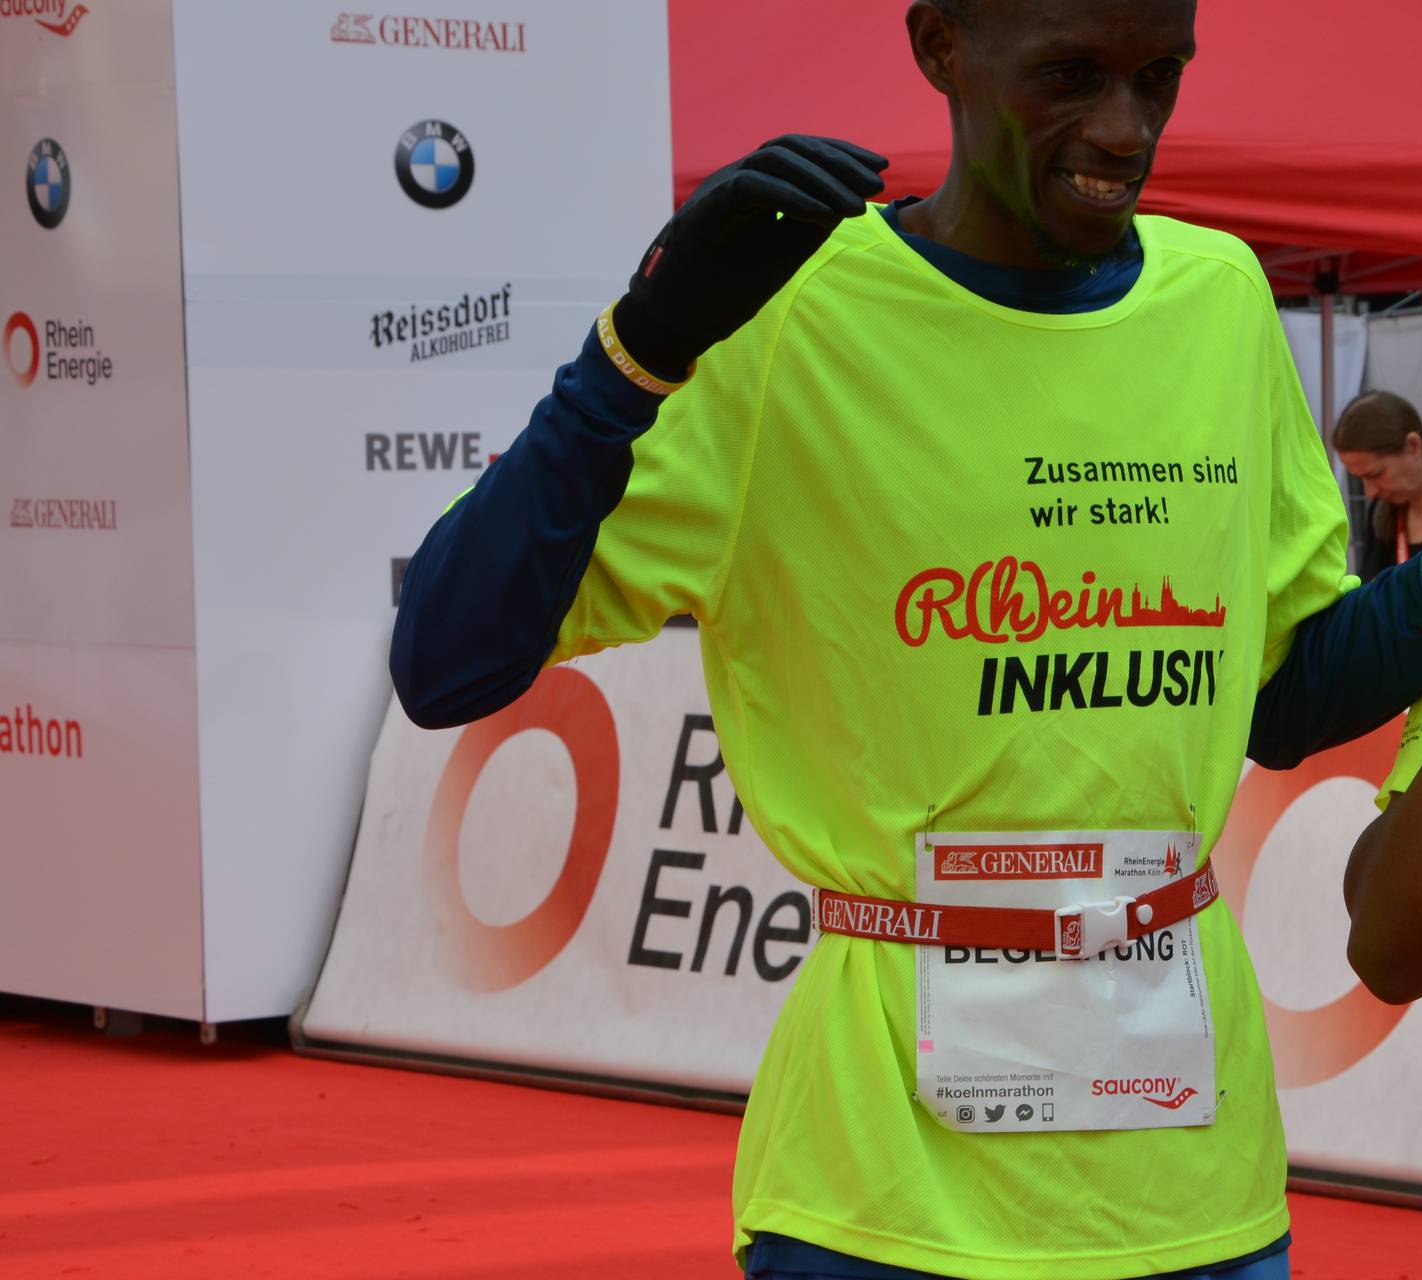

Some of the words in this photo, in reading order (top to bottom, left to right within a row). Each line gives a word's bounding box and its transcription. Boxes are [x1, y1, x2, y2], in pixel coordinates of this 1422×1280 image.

[379, 15, 527, 52] GENERALI
[369, 282, 512, 348] Reissdorf
[45, 319, 94, 348] Rhein
[410, 321, 510, 362] ALKOHOLFREI
[47, 350, 112, 386] Energie
[1024, 457, 1184, 486] Zusammen
[1192, 456, 1238, 484] sind
[34, 499, 117, 529] GENERALI
[1030, 498, 1078, 528] wir
[1090, 497, 1169, 526] stark!
[895, 556, 1124, 647] R(h)ein
[981, 850, 1097, 874] GENERALI
[1114, 868, 1146, 877] Marathon
[822, 897, 943, 940] GENERALI
[936, 1085, 1054, 1099] #koelnmarathon
[1091, 1077, 1176, 1097] saucony
